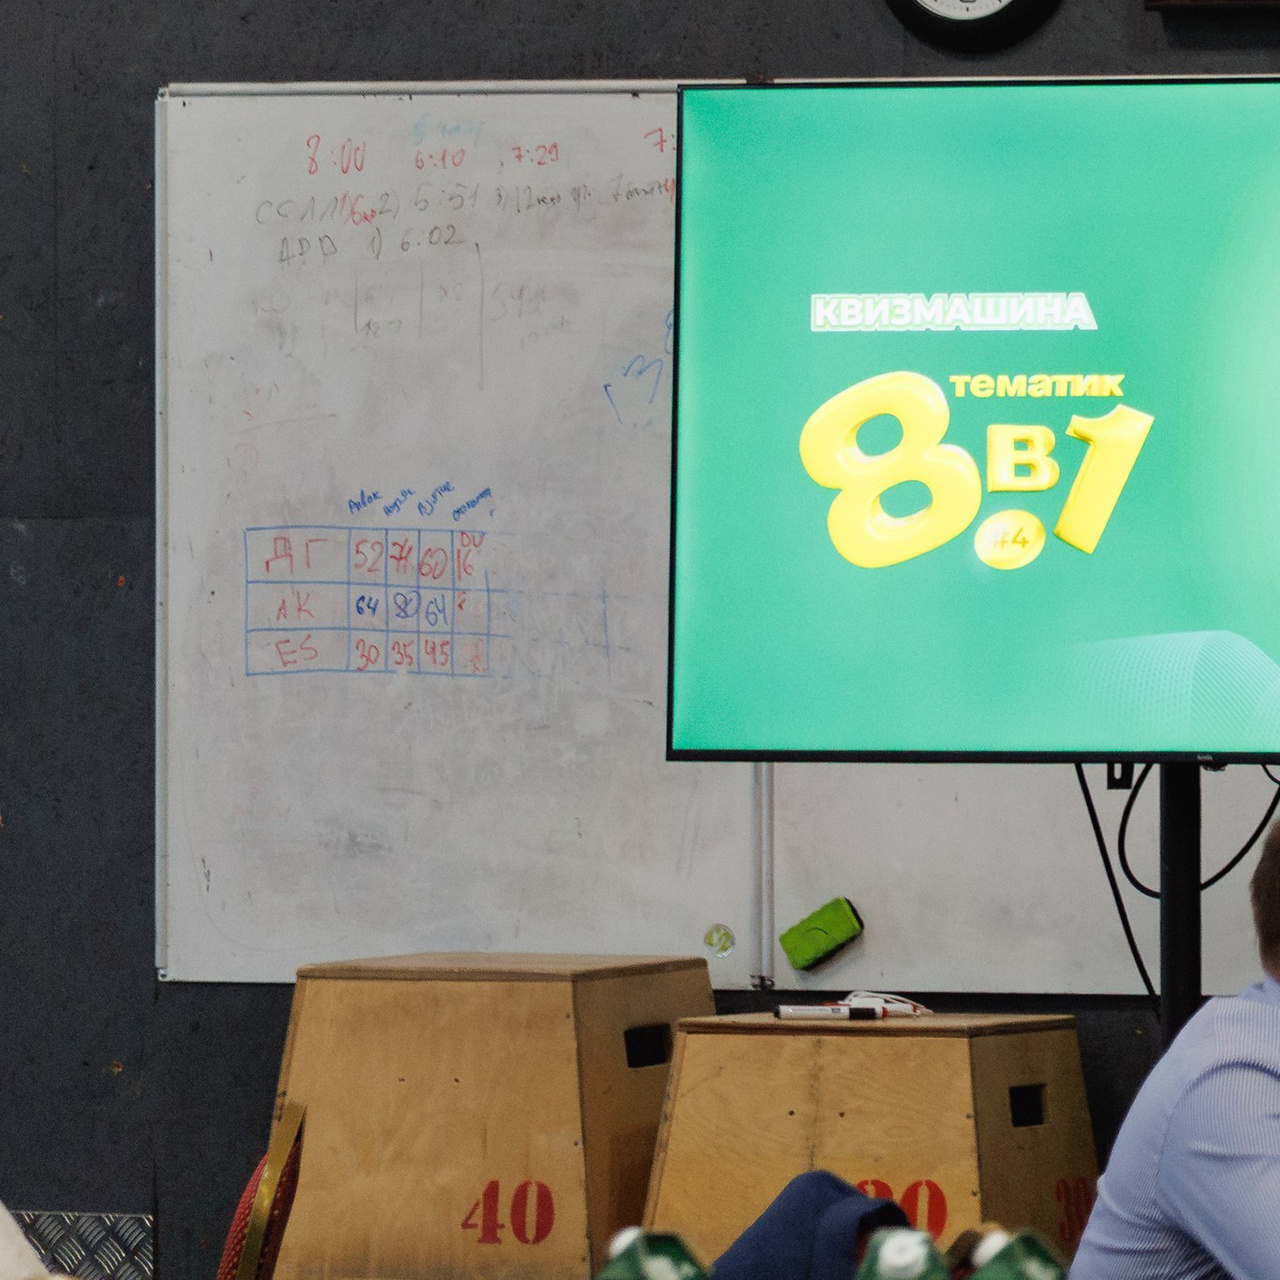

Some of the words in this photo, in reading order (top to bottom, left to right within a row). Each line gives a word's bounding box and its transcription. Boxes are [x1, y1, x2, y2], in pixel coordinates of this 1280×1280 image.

[811, 293, 1098, 331] КВИЗМАШИНА
[949, 373, 1125, 398] тематик
[799, 370, 982, 569] 8
[1053, 403, 1155, 555] 1
[460, 1179, 556, 1246] 40
